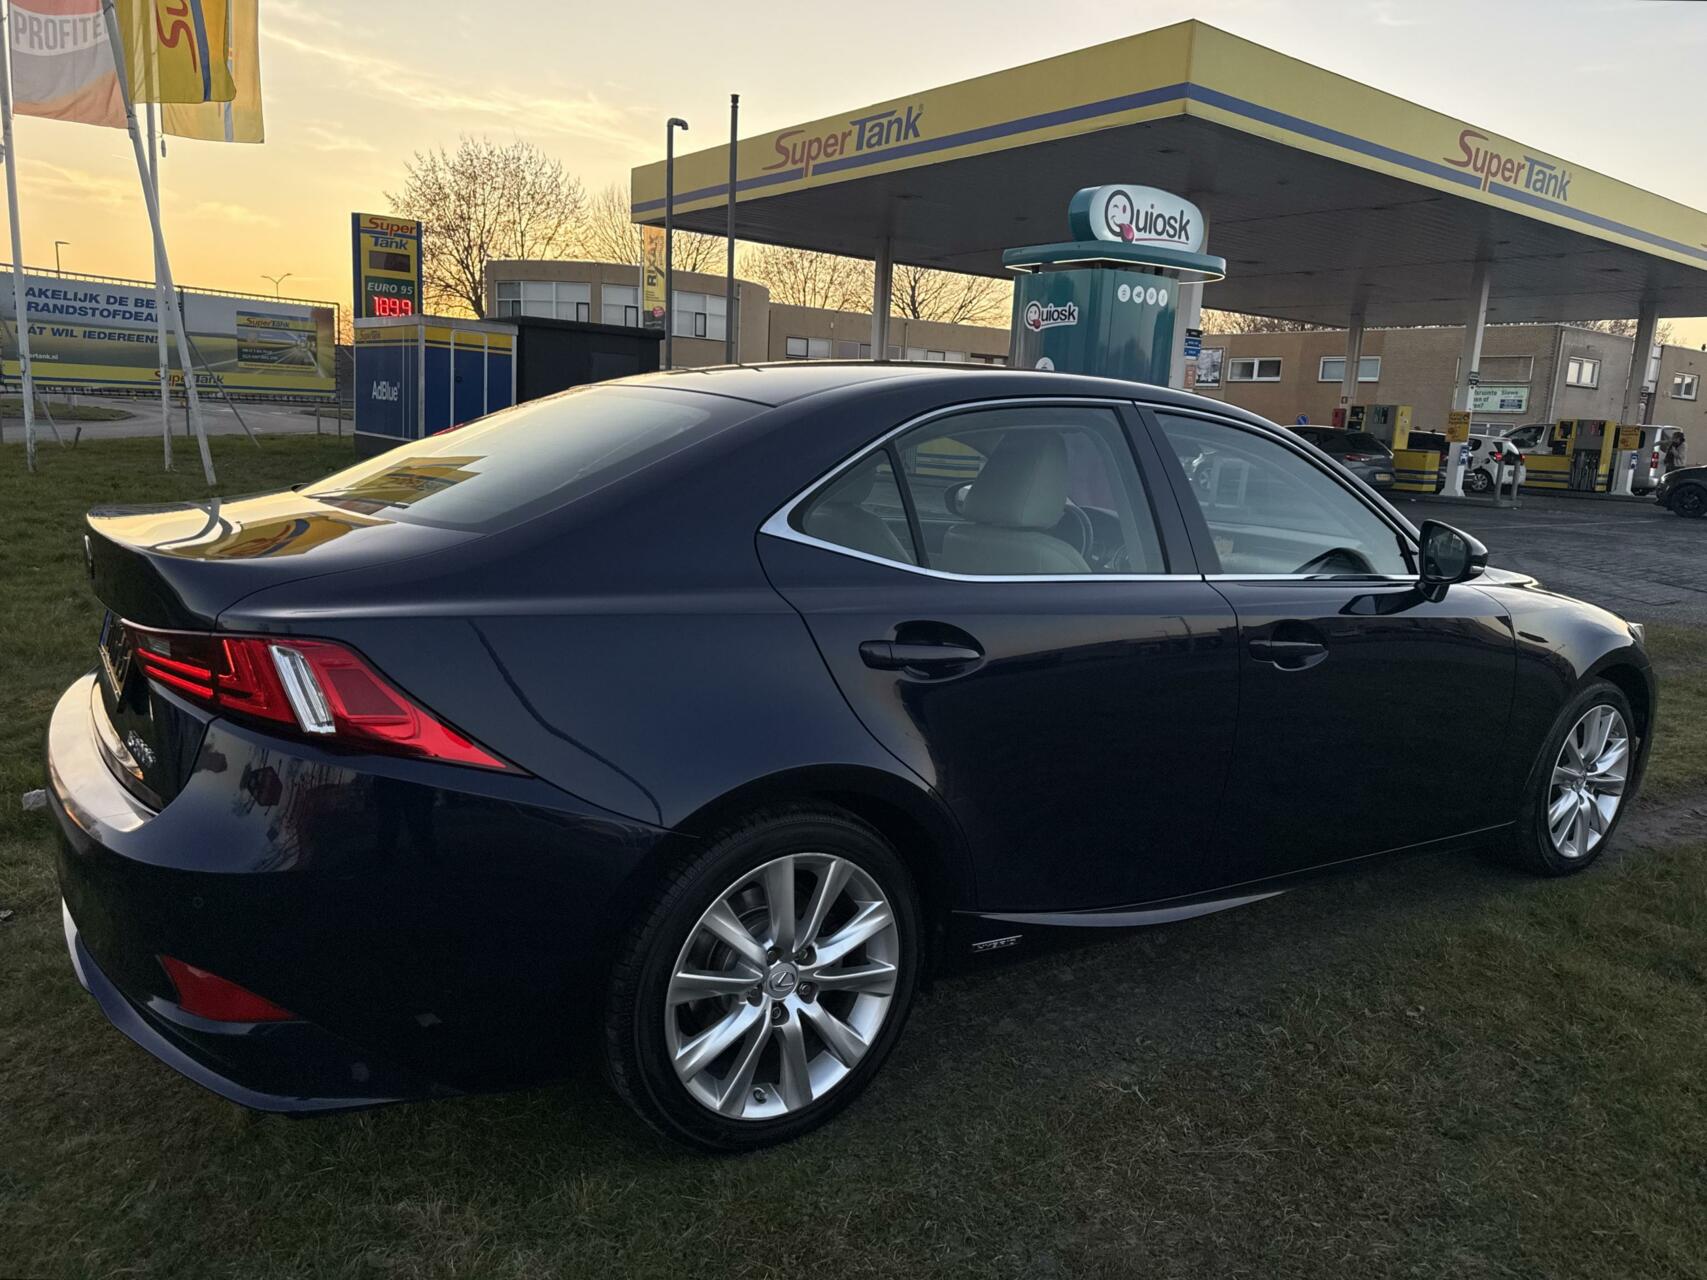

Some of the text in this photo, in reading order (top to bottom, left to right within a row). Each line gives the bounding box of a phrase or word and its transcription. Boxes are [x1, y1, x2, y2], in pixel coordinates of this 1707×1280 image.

[13, 14, 107, 50] PROFITE
[364, 217, 416, 237] Super
[1104, 190, 1190, 243] Quiosk
[370, 236, 409, 250] Tank
[12, 286, 100, 304] AKELIJK
[106, 295, 129, 307] DE
[367, 282, 413, 295] EURO 95
[13, 301, 159, 323] RANDSTOFDEA
[1026, 302, 1076, 329] Quiosk
[51, 328, 78, 338] WIL
[83, 330, 158, 344] IEDEREEN!
